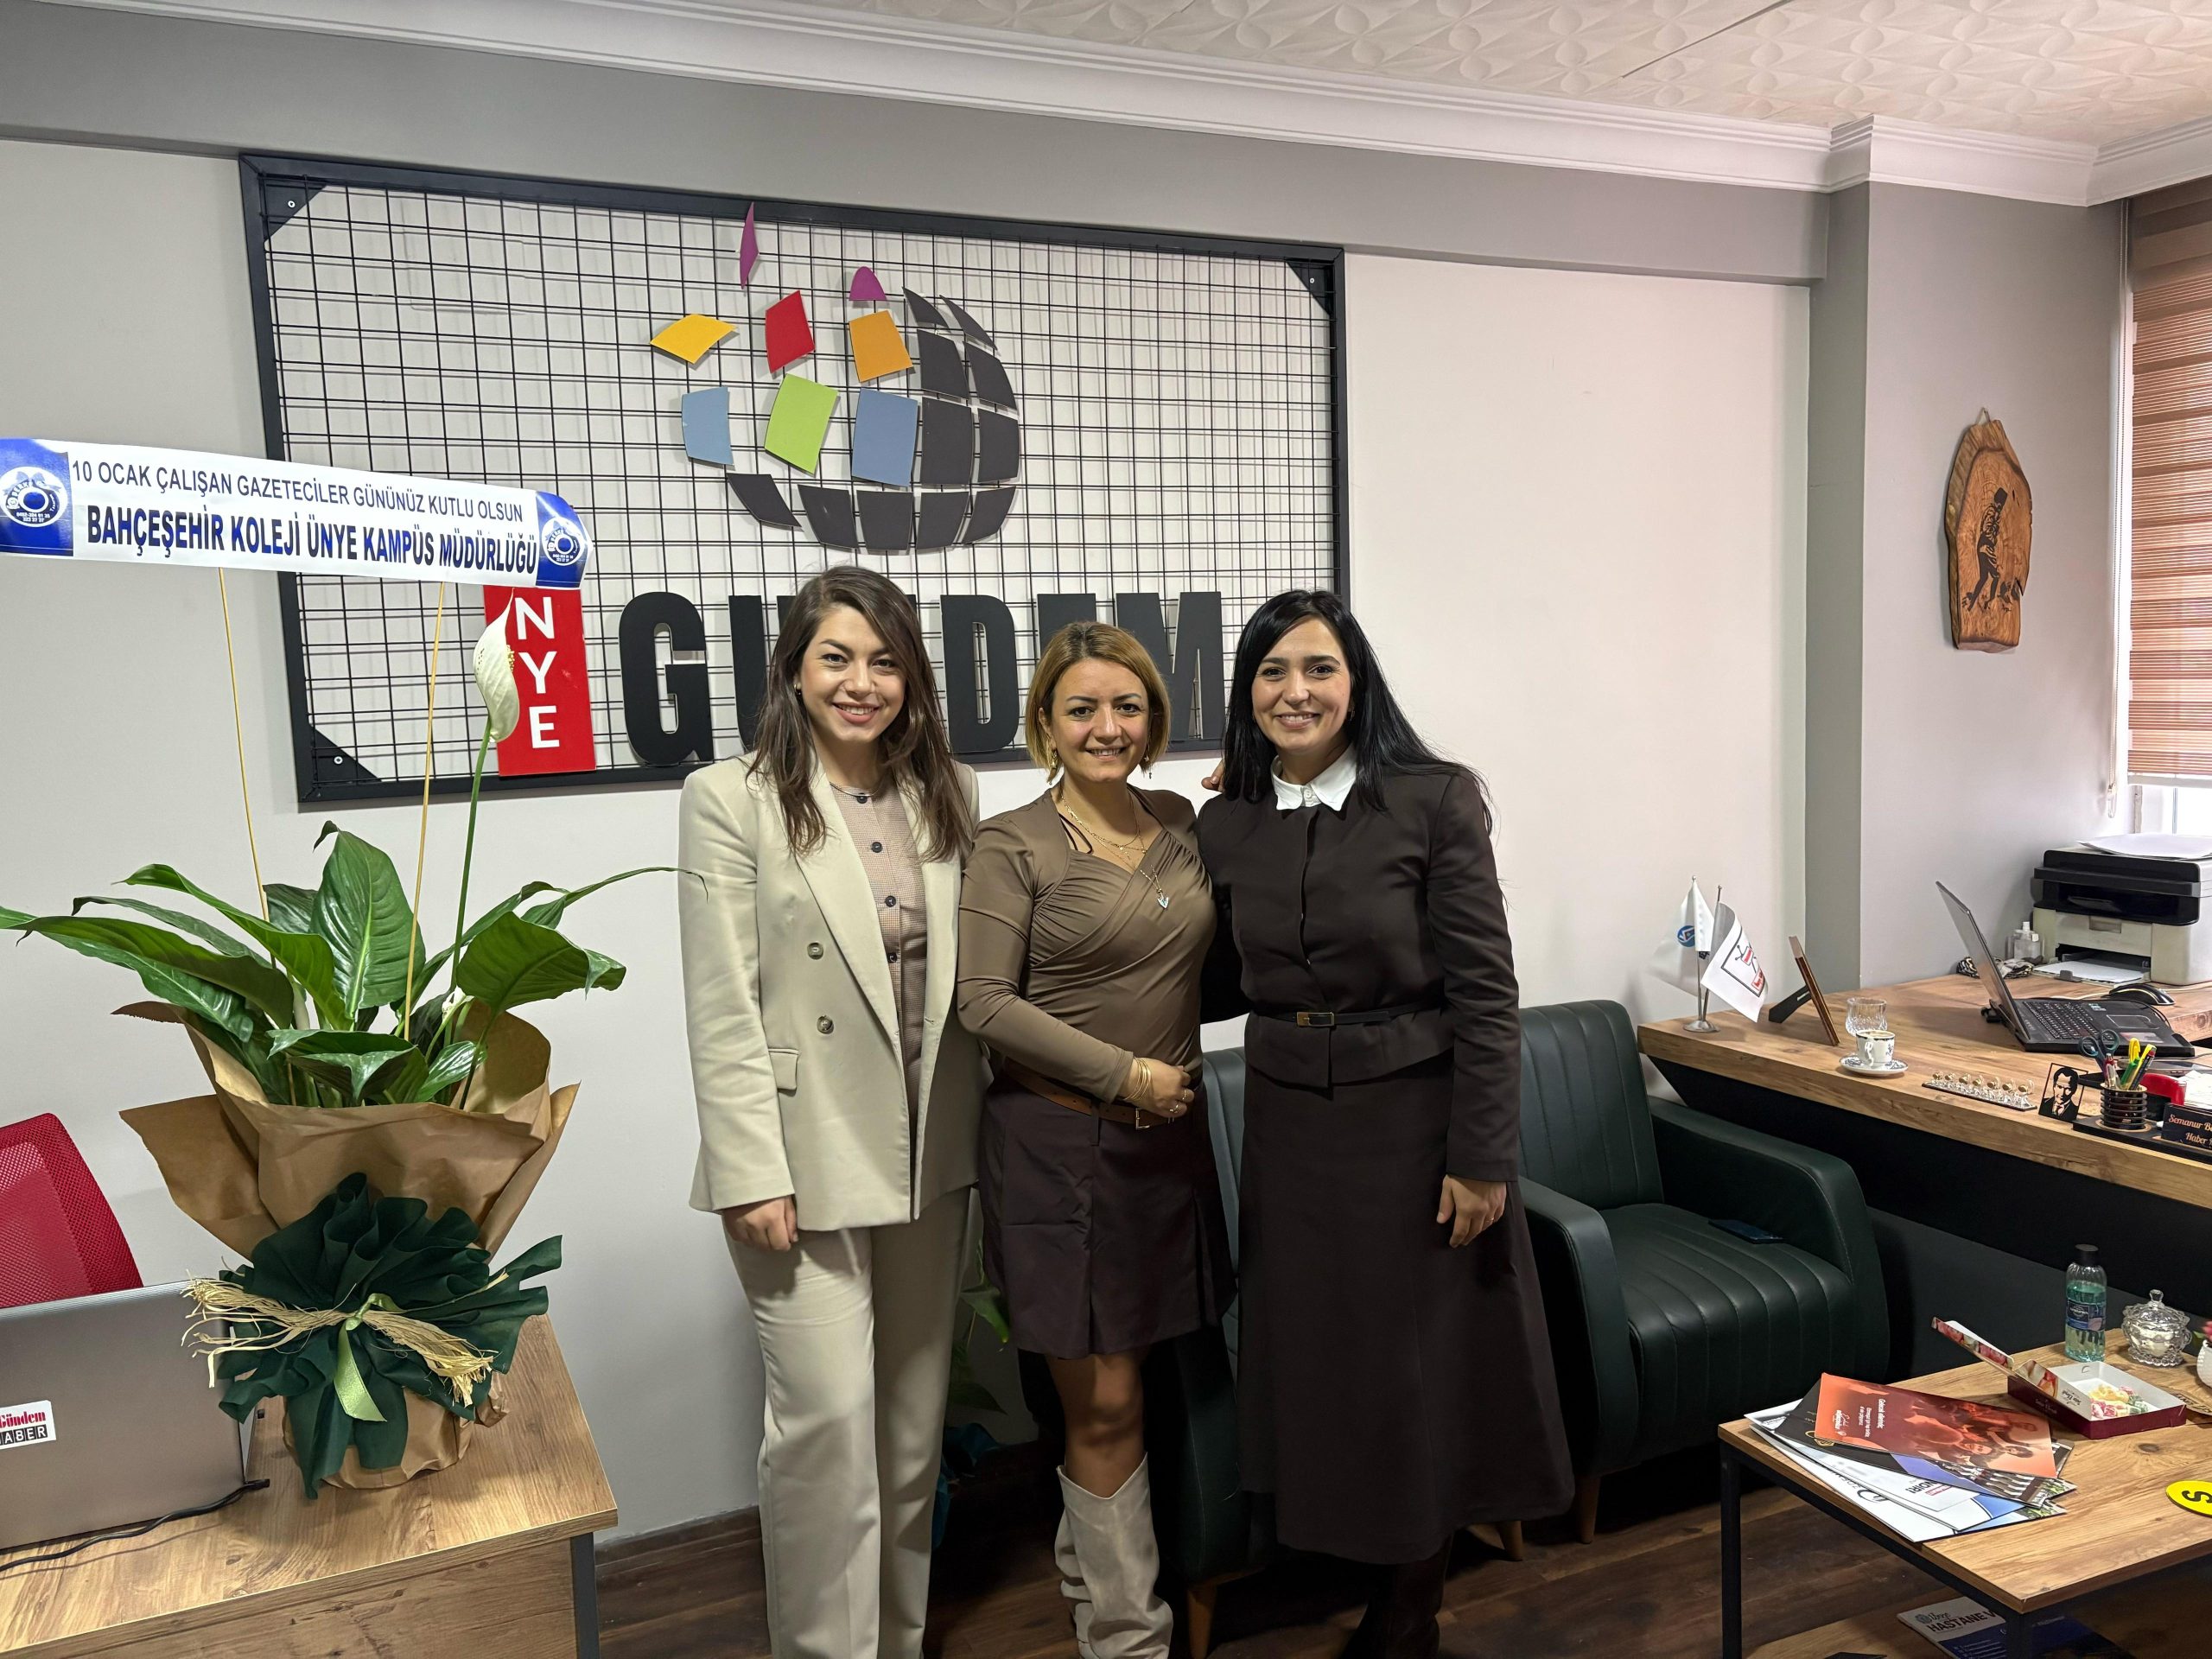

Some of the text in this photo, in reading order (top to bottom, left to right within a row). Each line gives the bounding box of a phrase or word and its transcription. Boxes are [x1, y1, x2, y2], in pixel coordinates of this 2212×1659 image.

[73, 460, 524, 523] 10 OCAK ÇALIŞAN GAZETECİLER GÜNÜNÜZ KUTLU OLSUN
[87, 504, 537, 575] BAHÇEŞEHİR KOLEJİ ÜNYE KAMPÜS MÜDÜRLÜĞÜ
[2169, 1113, 2203, 1128] Semanur
[2186, 1132, 2208, 1144] Haber
[0, 1425, 48, 1446] ABER
[1927, 1611, 1987, 1632] HASTANE
